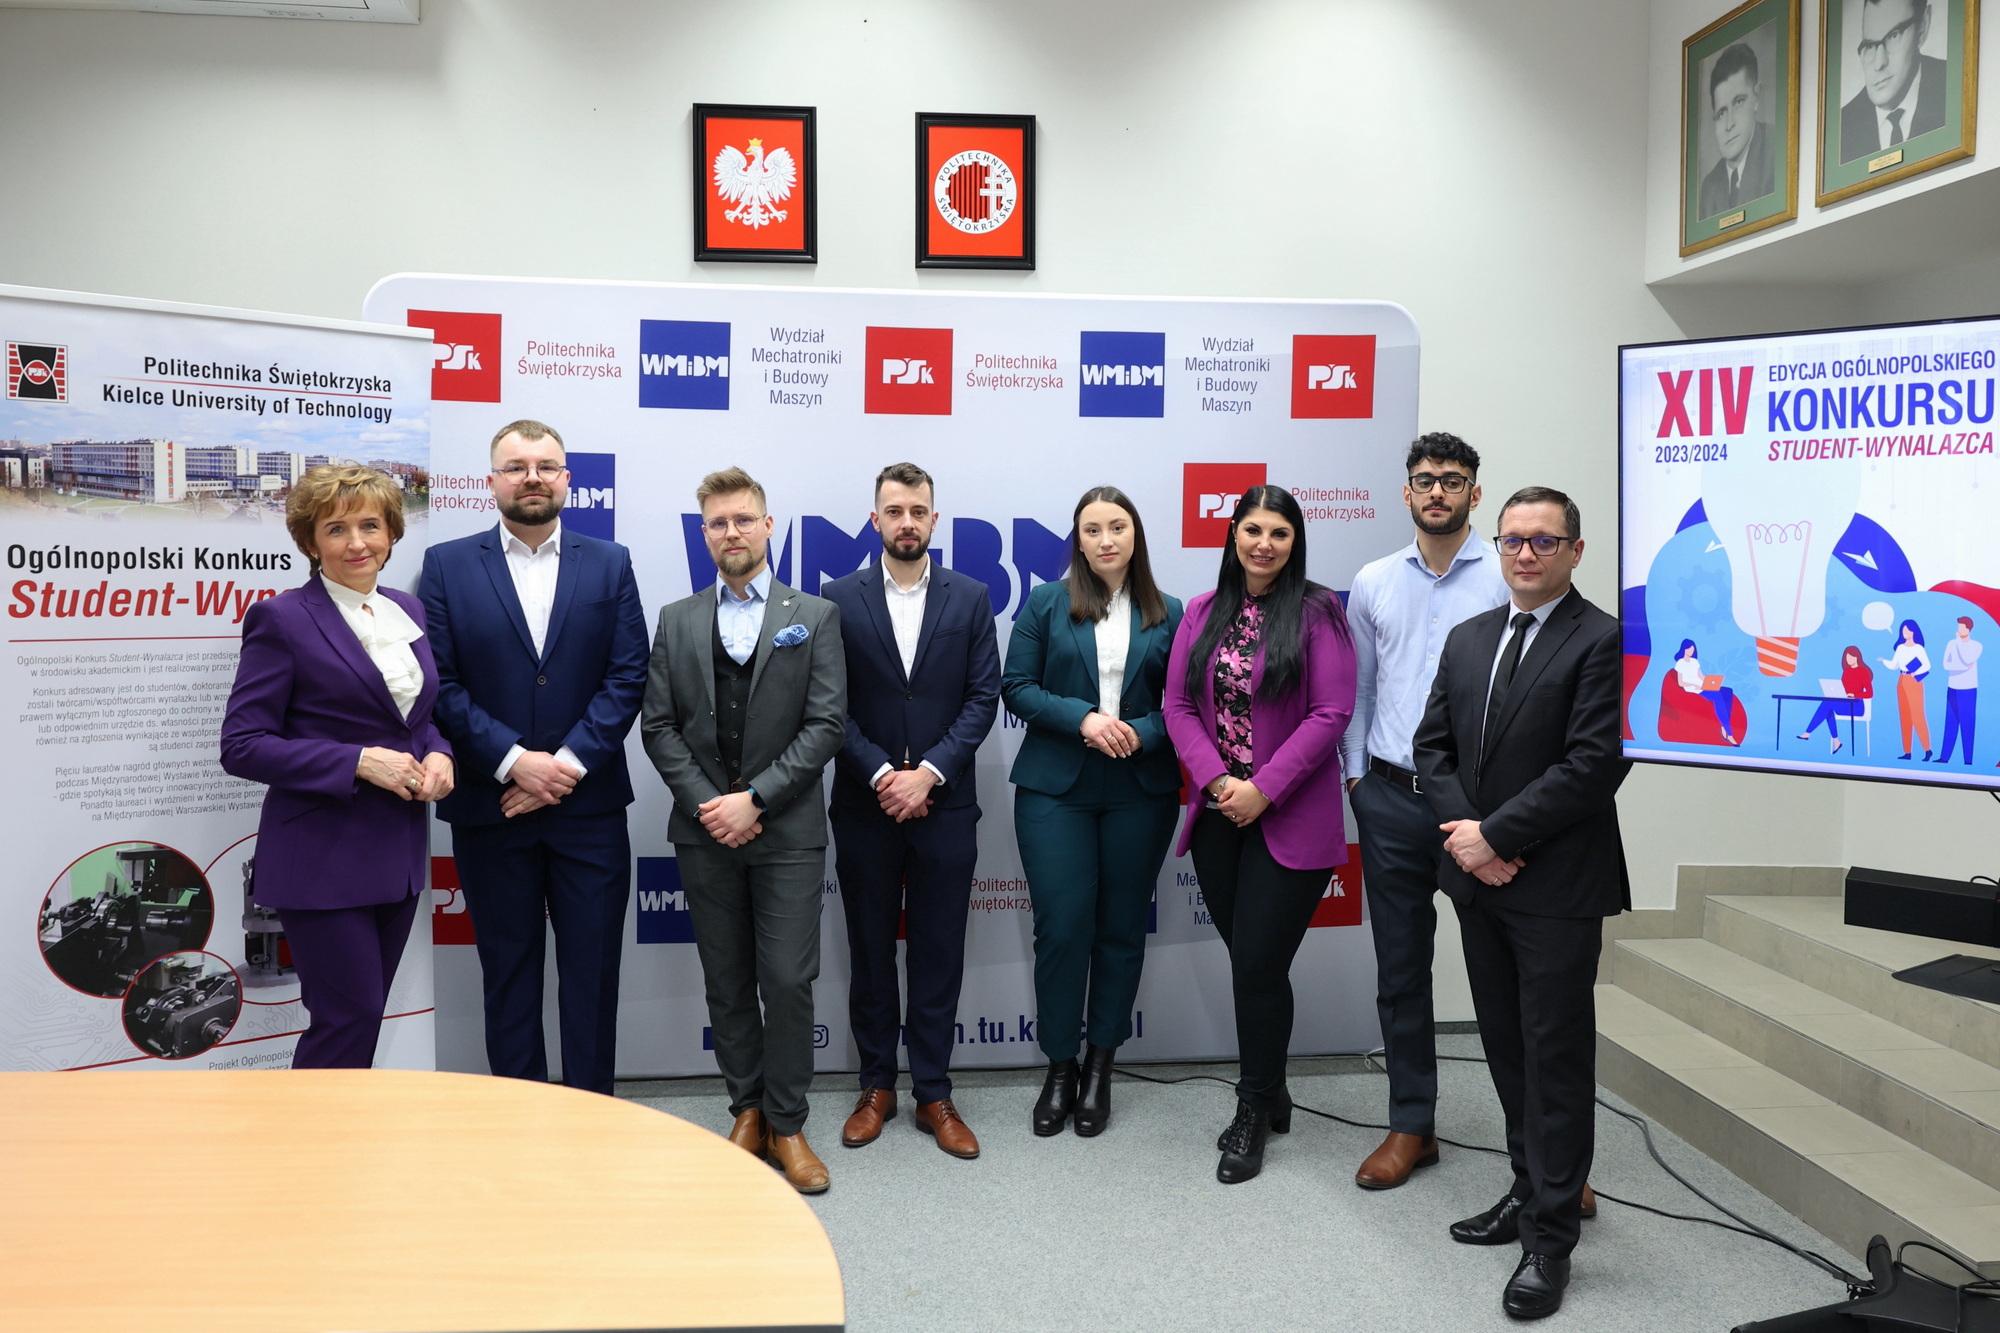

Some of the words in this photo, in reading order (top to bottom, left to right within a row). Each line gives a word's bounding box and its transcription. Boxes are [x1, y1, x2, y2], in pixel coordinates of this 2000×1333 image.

[939, 153, 1012, 183] POLITECHNIKA
[938, 197, 1013, 231] ŚWIĘTOKRZYSKA
[770, 327, 824, 345] Wydział
[527, 340, 615, 358] Politechnika
[1202, 337, 1254, 354] Wydział
[641, 353, 728, 377] WMiBM
[751, 348, 842, 364] Mechatroniki
[975, 354, 1057, 370] Politechnika
[1184, 357, 1271, 372] Mechatroniki
[144, 356, 262, 383] Politechnika
[269, 363, 392, 393] Świętokrzyska
[517, 356, 622, 379] Świętokrzyska
[1081, 364, 1164, 386] WMiBM
[1768, 361, 1827, 382] EDYCJA
[1832, 350, 1996, 378] OGÓLNOPOLSKIEGO
[764, 370, 768, 383] i
[773, 370, 829, 388] Budowy
[966, 371, 1064, 391] Świętokrzyska
[1196, 377, 1200, 391] i
[1205, 377, 1258, 395] Budowy
[103, 384, 164, 406] Kielce
[172, 389, 266, 415] University
[273, 398, 290, 414] of
[296, 398, 392, 424] Technology
[769, 390, 822, 408] Maszyn
[1201, 397, 1252, 414] Maszyn
[1656, 366, 1754, 438] XIV
[1768, 378, 1995, 432] KONKURSU
[1655, 443, 1728, 463] 2023/2024
[1768, 432, 1994, 461] STUDENT-WYNALAZCA
[429, 474, 488, 490] olitechni
[1291, 487, 1370, 501] Politechnika
[1301, 505, 1375, 522] iętokrzyska
[7, 544, 183, 574] Ogólnopolski
[194, 547, 292, 570] Konkurs
[8, 579, 291, 624] Student-Wy
[17, 655, 73, 666] Ogólnopolski
[75, 654, 107, 663] Konkurs
[109, 652, 183, 663] Student-Wynalazca
[185, 651, 200, 662] jest
[31, 669, 38, 677] w
[40, 667, 86, 677] środowisku
[88, 664, 141, 675] akademickim
[148, 664, 163, 675] jest
[165, 662, 209, 673] realizowany
[211, 662, 232, 672] przez
[32, 687, 67, 697] Konkurs
[68, 685, 115, 696] adresowany
[117, 684, 132, 695] jest
[134, 683, 145, 692] do
[147, 682, 190, 692] studentów,
[27, 699, 54, 709] zostali
[56, 695, 156, 707] twórcami/współtwórcami
[157, 693, 198, 704] wynalazku
[199, 693, 212, 702] lub
[19, 713, 53, 723] prawem
[55, 710, 100, 721] wyłącznym
[102, 708, 115, 718] lub
[117, 706, 167, 718] zgłoszonego
[168, 706, 180, 715] do
[181, 705, 212, 715] ochrony
[213, 705, 220, 713] w
[38, 724, 52, 733] lub
[54, 722, 109, 733] odpowiednim
[111, 719, 144, 730] urzędzie
[146, 719, 159, 728] ds.
[161, 717, 199, 727] własności
[35, 736, 68, 746] również
[69, 736, 80, 744] na
[81, 732, 123, 744] zgłoszenia
[125, 731, 169, 742] wynikające
[170, 730, 180, 738] ze
[181, 728, 221, 738] współprac
[148, 743, 158, 752] są
[160, 741, 194, 750] studenci
[55, 766, 81, 777] Pięciu
[82, 763, 121, 774] laureatów
[122, 761, 151, 772] nagród
[152, 759, 190, 771] głównych
[55, 778, 89, 789] podczas
[91, 773, 161, 785] Międzynarodowej
[163, 771, 200, 782] Wystawie
[60, 791, 82, 801] gdzie
[83, 787, 122, 799] spotykają
[123, 786, 136, 796] się
[138, 784, 164, 795] twórcy
[166, 780, 223, 793] innowacyjnych
[80, 801, 113, 810] Ponadto
[115, 798, 147, 807] laureaci
[154, 794, 195, 806] wyróżnieni
[205, 791, 243, 802] Konkursie
[91, 813, 102, 821] na
[104, 808, 174, 821] Międzynarodowej
[175, 803, 226, 815] Warszawskiej
[228, 801, 263, 811] Wystawie
[241, 1048, 295, 1067] Ogólnopolsk
